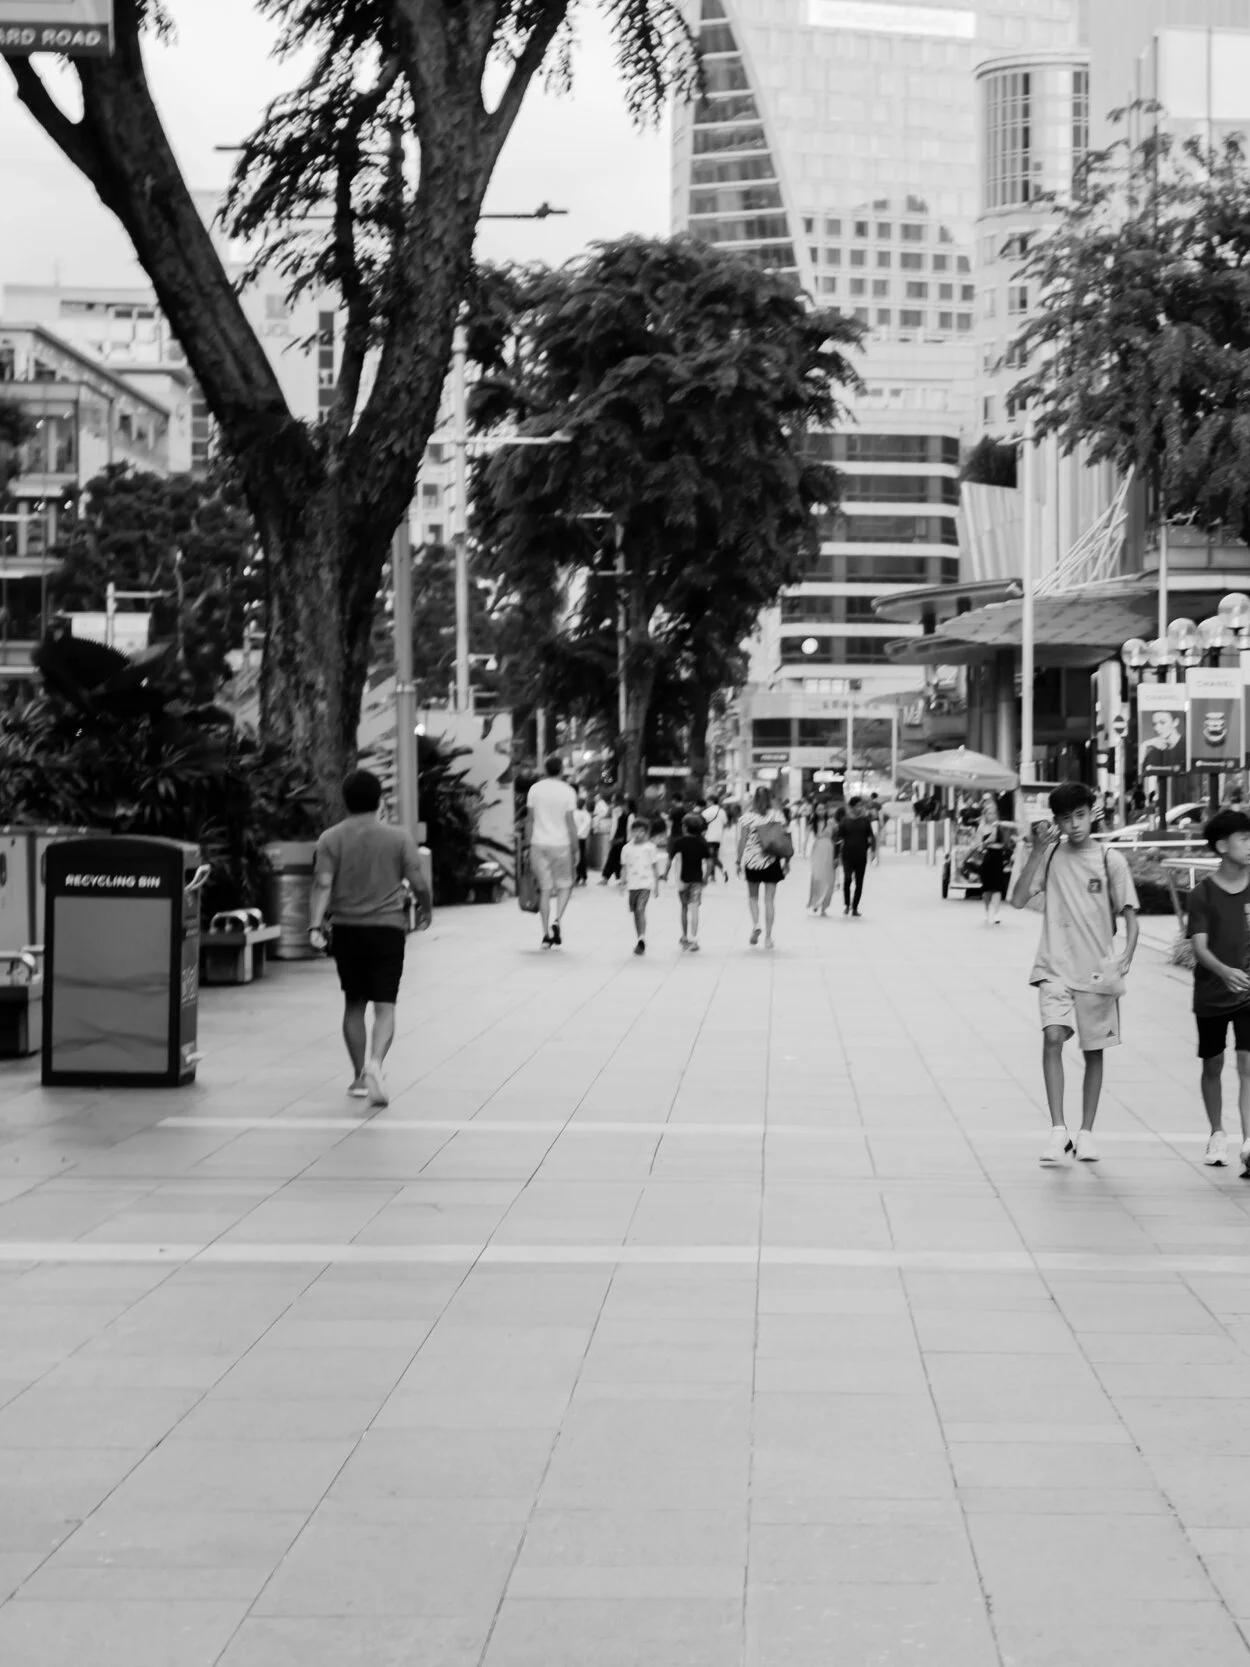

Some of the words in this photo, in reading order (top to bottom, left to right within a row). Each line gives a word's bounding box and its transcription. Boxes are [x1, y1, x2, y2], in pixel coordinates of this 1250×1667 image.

[41, 28, 102, 46] ROAD
[65, 873, 137, 888] RECYCLING
[138, 875, 161, 888] BIN
